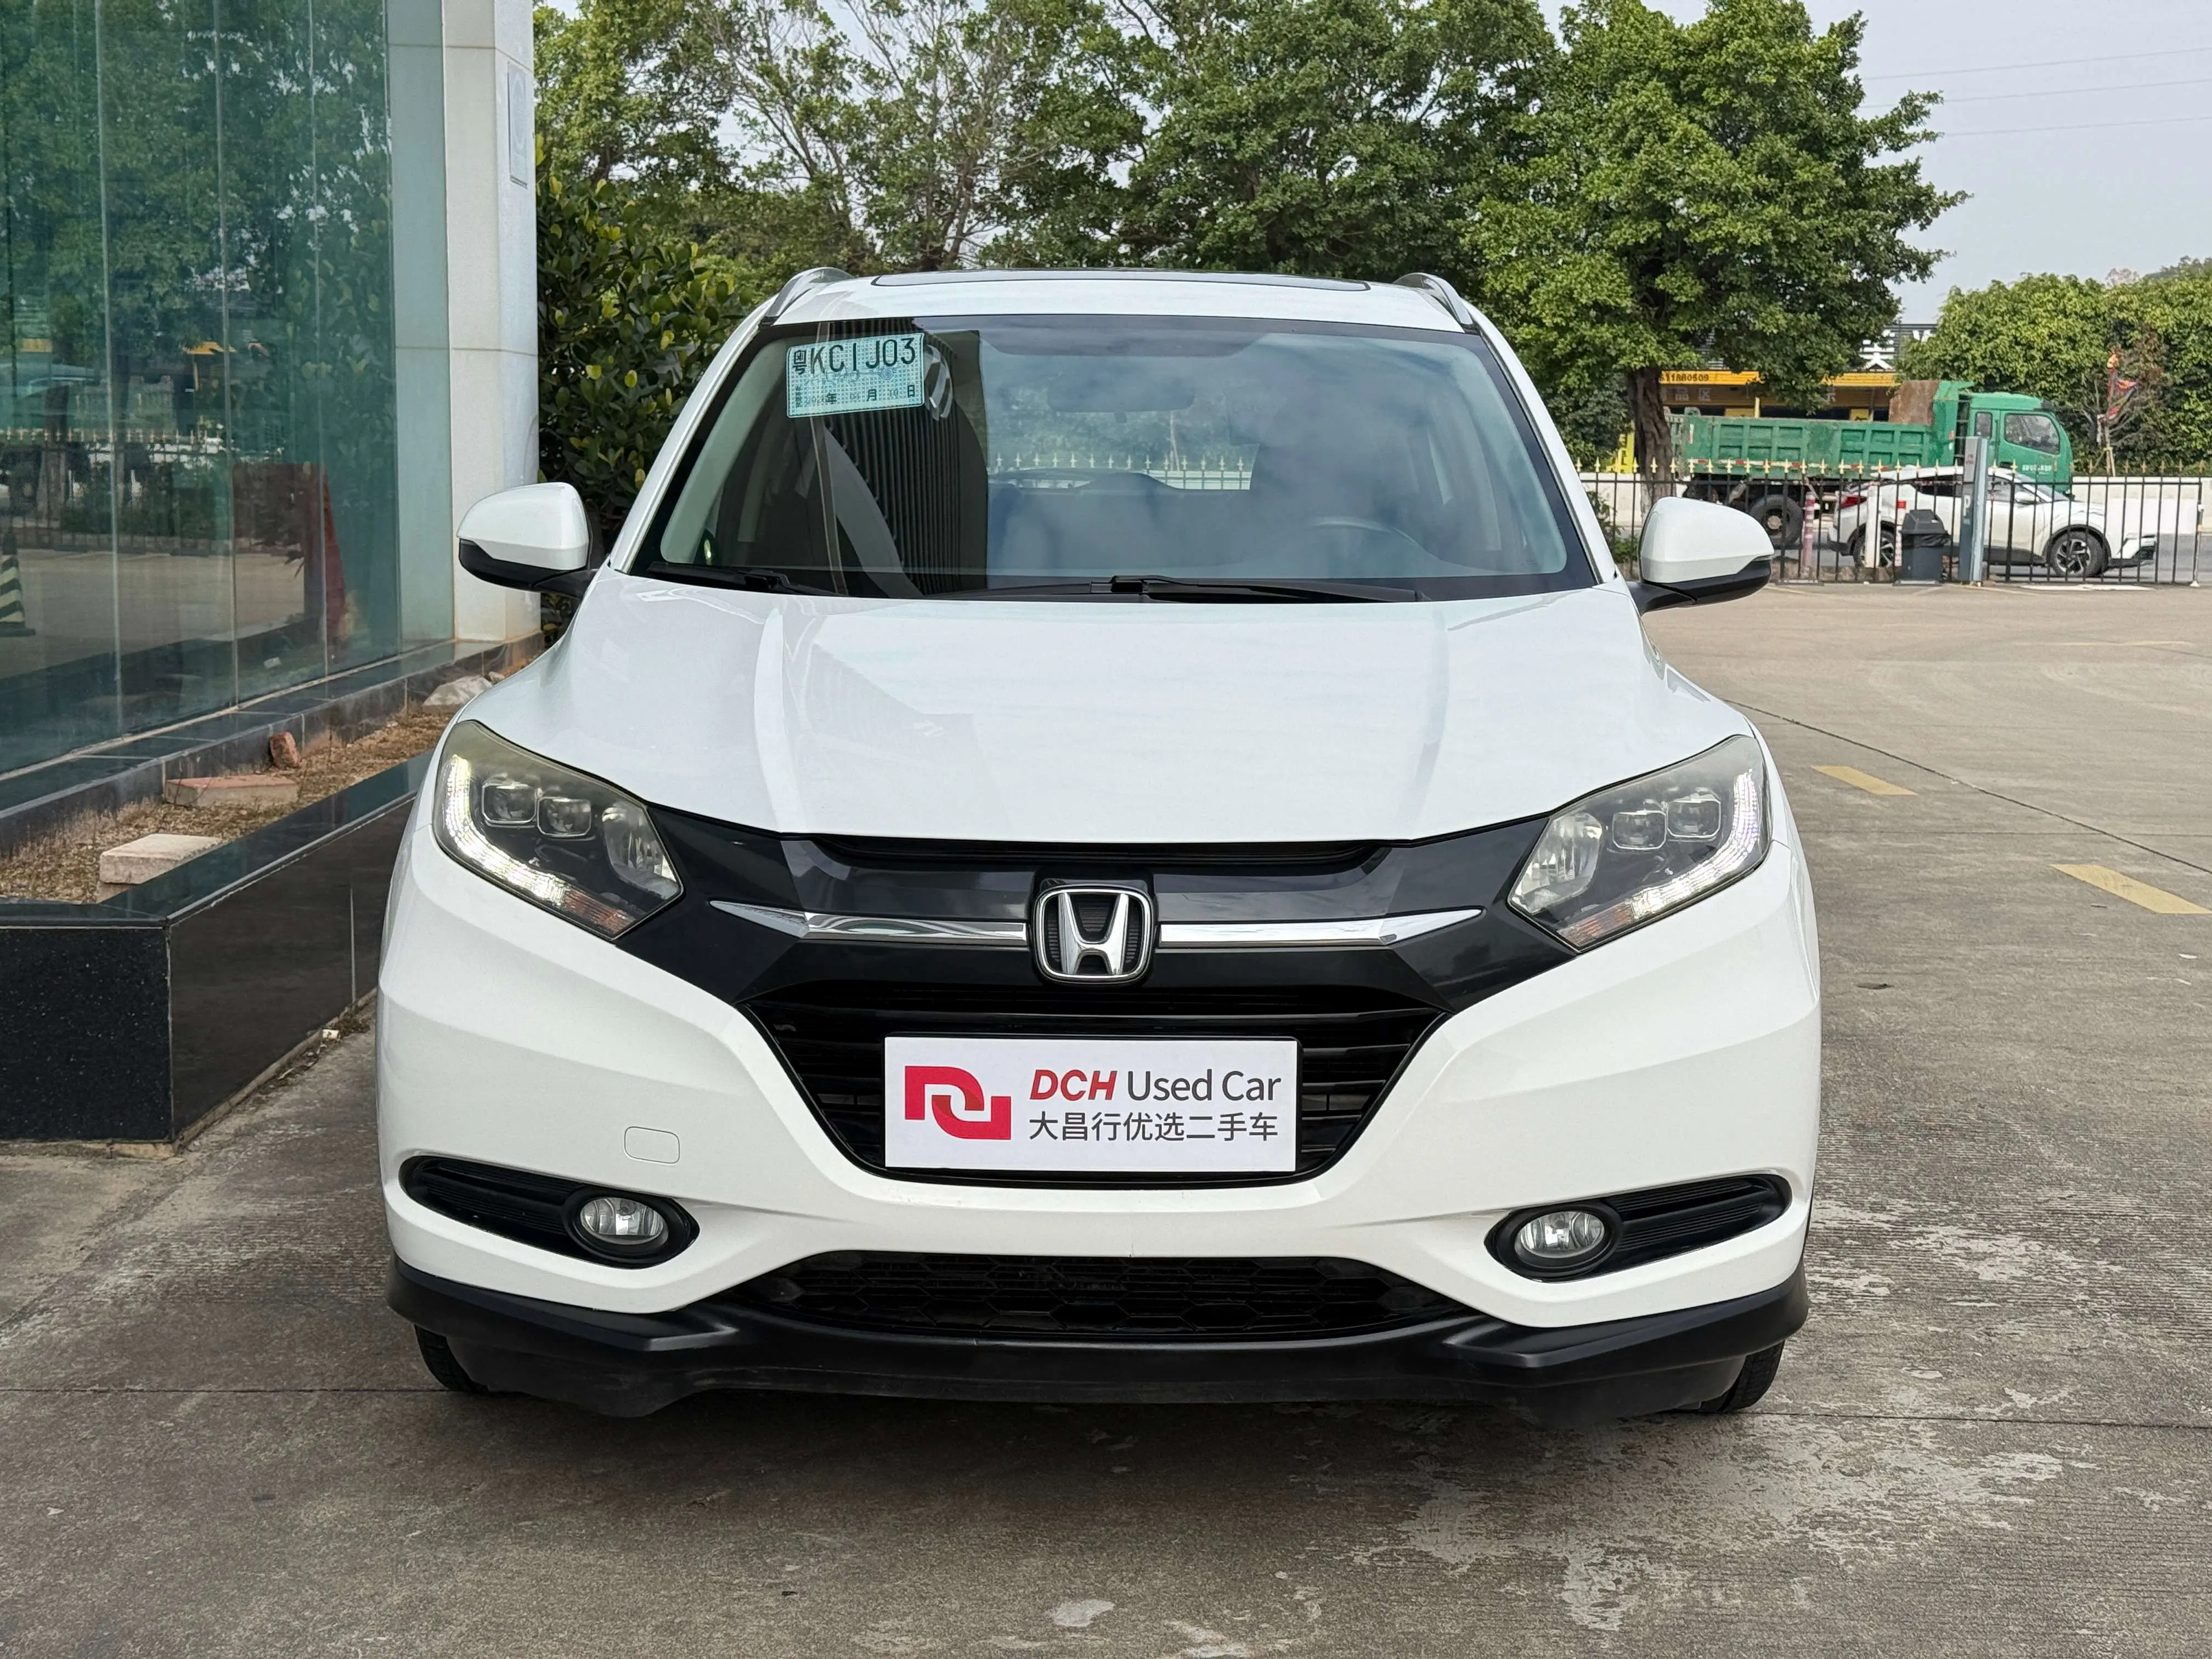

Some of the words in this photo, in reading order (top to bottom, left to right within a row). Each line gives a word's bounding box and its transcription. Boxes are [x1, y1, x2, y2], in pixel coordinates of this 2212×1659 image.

[1030, 1069, 1117, 1101] DCH
[1128, 1069, 1212, 1101] Used
[1222, 1070, 1282, 1101] Car
[1029, 1111, 1278, 1141] 大昌行优选二手车
